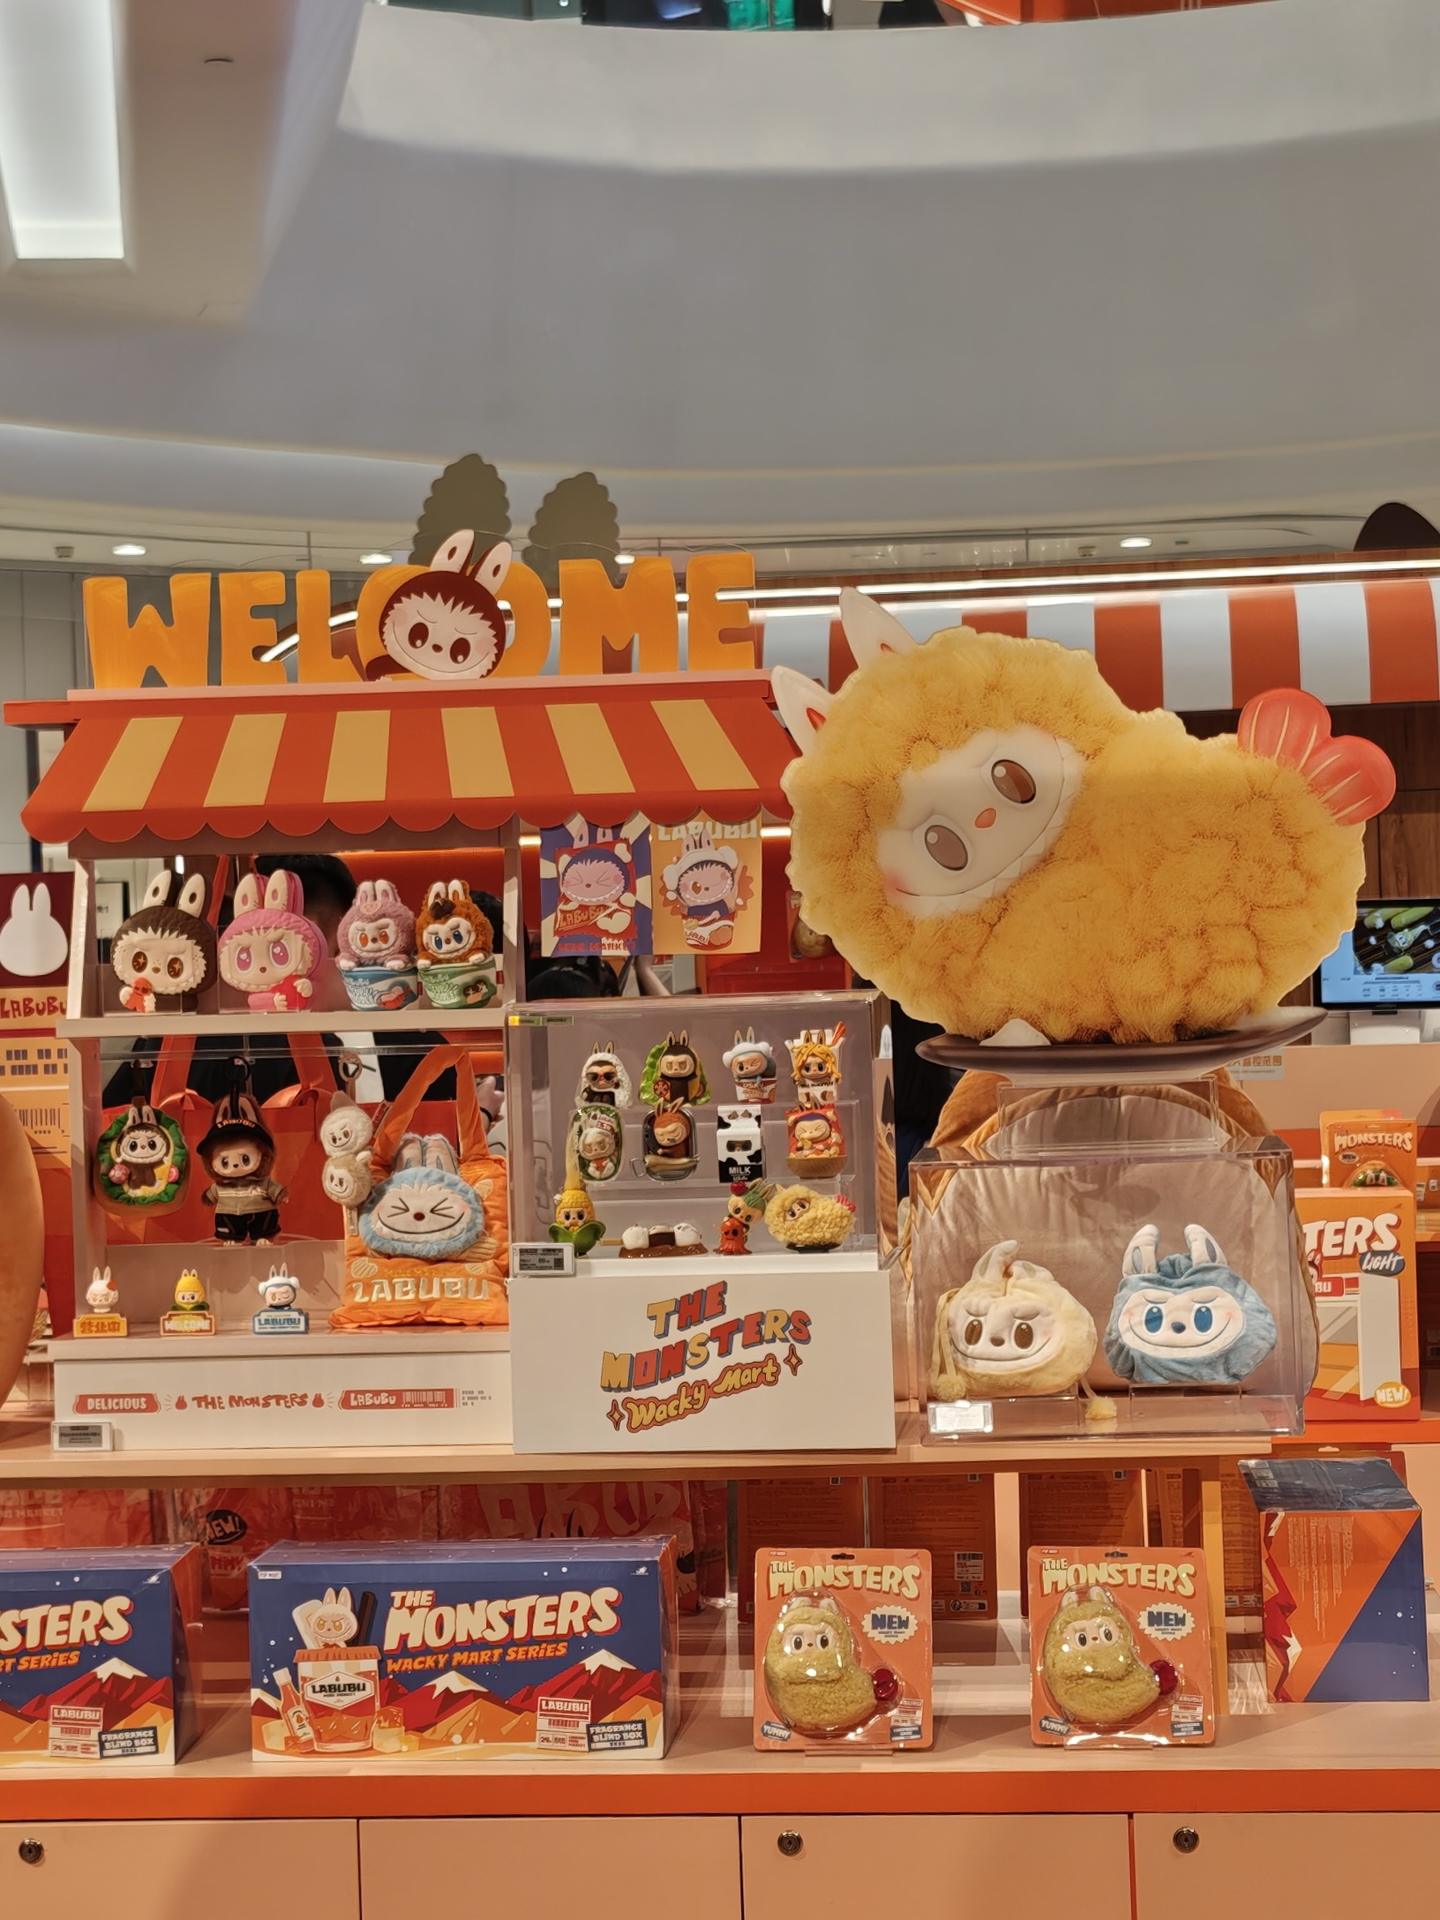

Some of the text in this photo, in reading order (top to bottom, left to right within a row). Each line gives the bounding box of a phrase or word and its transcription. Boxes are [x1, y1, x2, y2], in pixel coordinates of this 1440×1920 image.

[558, 905, 605, 926] LABUBU
[1334, 1132, 1414, 1153] MONSTERS
[728, 1166, 751, 1175] MILK
[1361, 1252, 1405, 1272] LIGHT
[351, 1276, 489, 1303] LABUBU
[647, 1280, 727, 1339] THE
[257, 1316, 302, 1326] LABUBU
[600, 1308, 812, 1393] MONSTERS
[191, 1392, 309, 1410] THE MONSTERS
[350, 1392, 396, 1407] LABUBU
[624, 1356, 780, 1431] Wacky Mart
[86, 1396, 147, 1411] DELICIOUS
[769, 1560, 796, 1574] THE
[1043, 1557, 1068, 1571] THE
[769, 1564, 922, 1600] MONSTERS
[1042, 1562, 1197, 1599] MONSTERS
[390, 1589, 435, 1608] THE
[384, 1586, 622, 1654] MONSTERS
[871, 1612, 910, 1630] NEW
[1146, 1610, 1186, 1627] NEW
[386, 1653, 449, 1673] WACKY
[452, 1648, 503, 1667] MART
[311, 1682, 366, 1694] LABUBU
[53, 1708, 100, 1720] LABUBU
[541, 1699, 588, 1713] LABUBU
[590, 1723, 643, 1735] FRAGRANCE
[762, 1724, 791, 1739] YUMMY
[1040, 1719, 1069, 1734] YUMMY
[101, 1729, 154, 1741] FRAGRANCE
[134, 1737, 154, 1747] BOX
[622, 1730, 643, 1740] BOX
